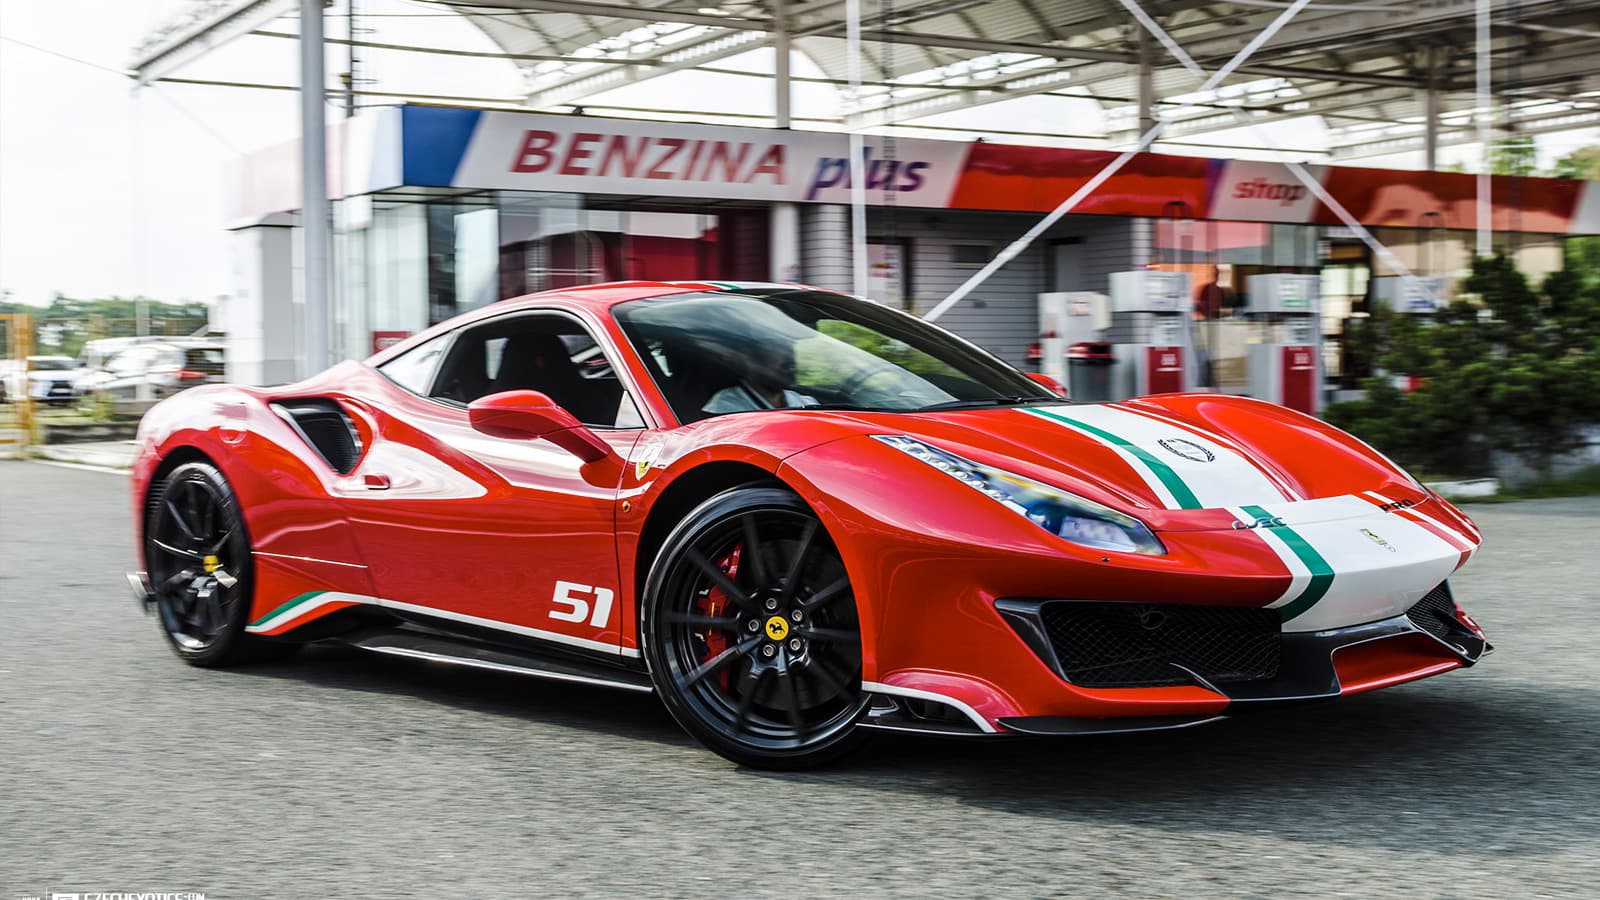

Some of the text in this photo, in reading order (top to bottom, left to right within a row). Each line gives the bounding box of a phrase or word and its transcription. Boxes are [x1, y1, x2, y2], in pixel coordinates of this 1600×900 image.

[510, 130, 931, 200] BENZINA plus
[1379, 499, 1415, 512] PRO
[548, 580, 614, 629] 51
